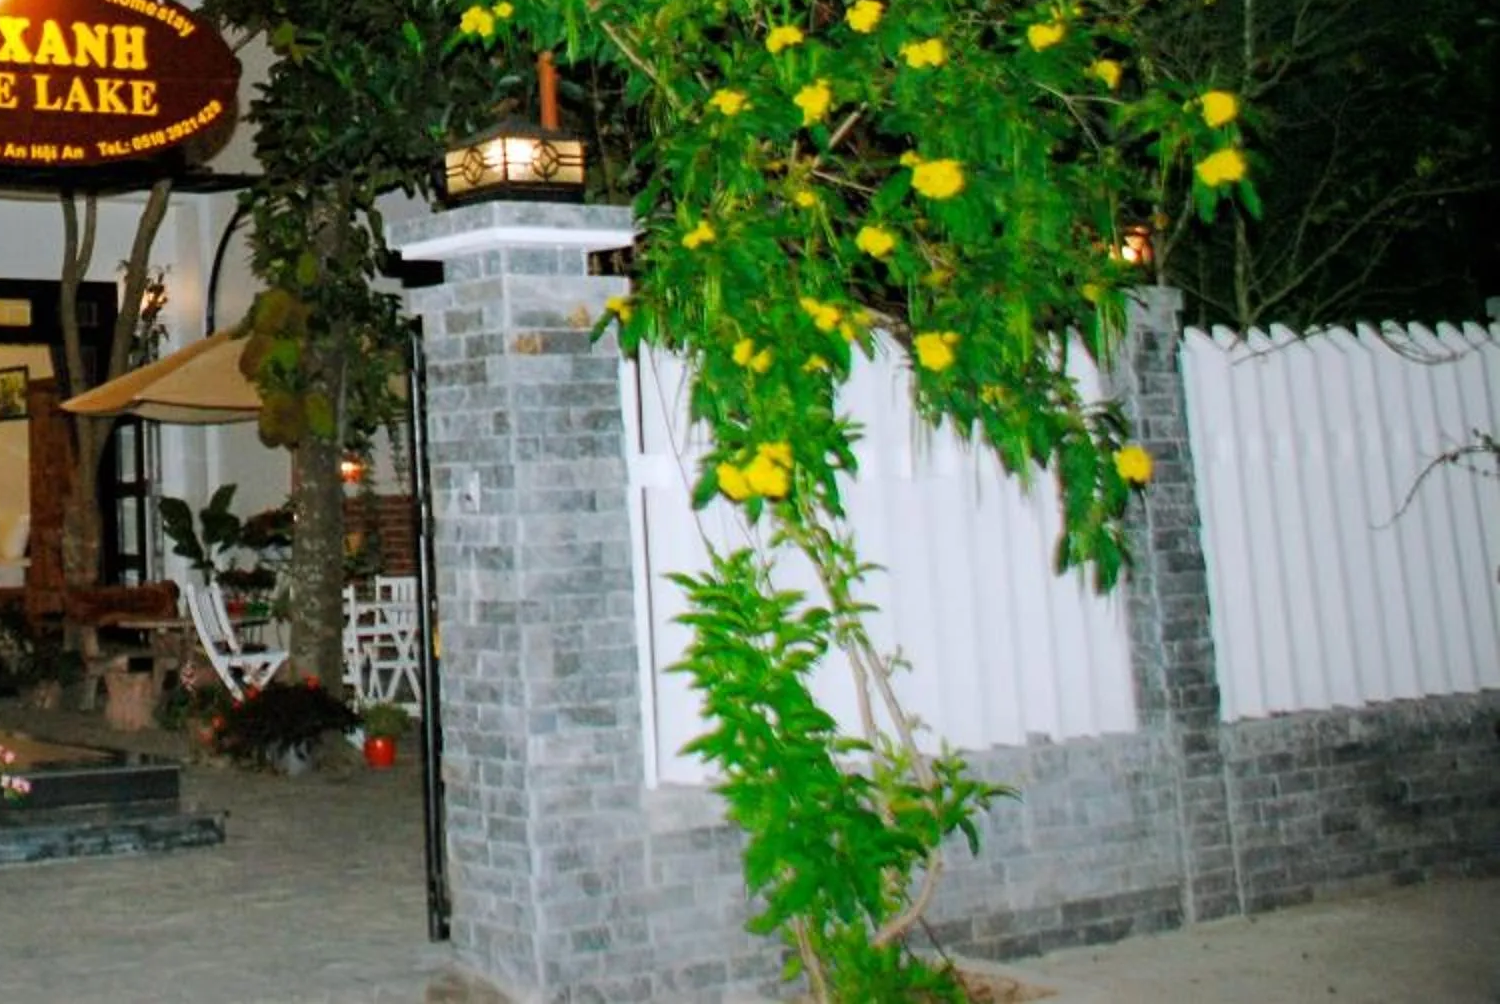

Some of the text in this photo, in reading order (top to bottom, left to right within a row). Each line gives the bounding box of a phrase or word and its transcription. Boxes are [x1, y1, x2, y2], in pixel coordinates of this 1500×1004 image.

[32, 74, 159, 116] LAKE
[3, 142, 27, 159] An
[61, 144, 85, 160] An
